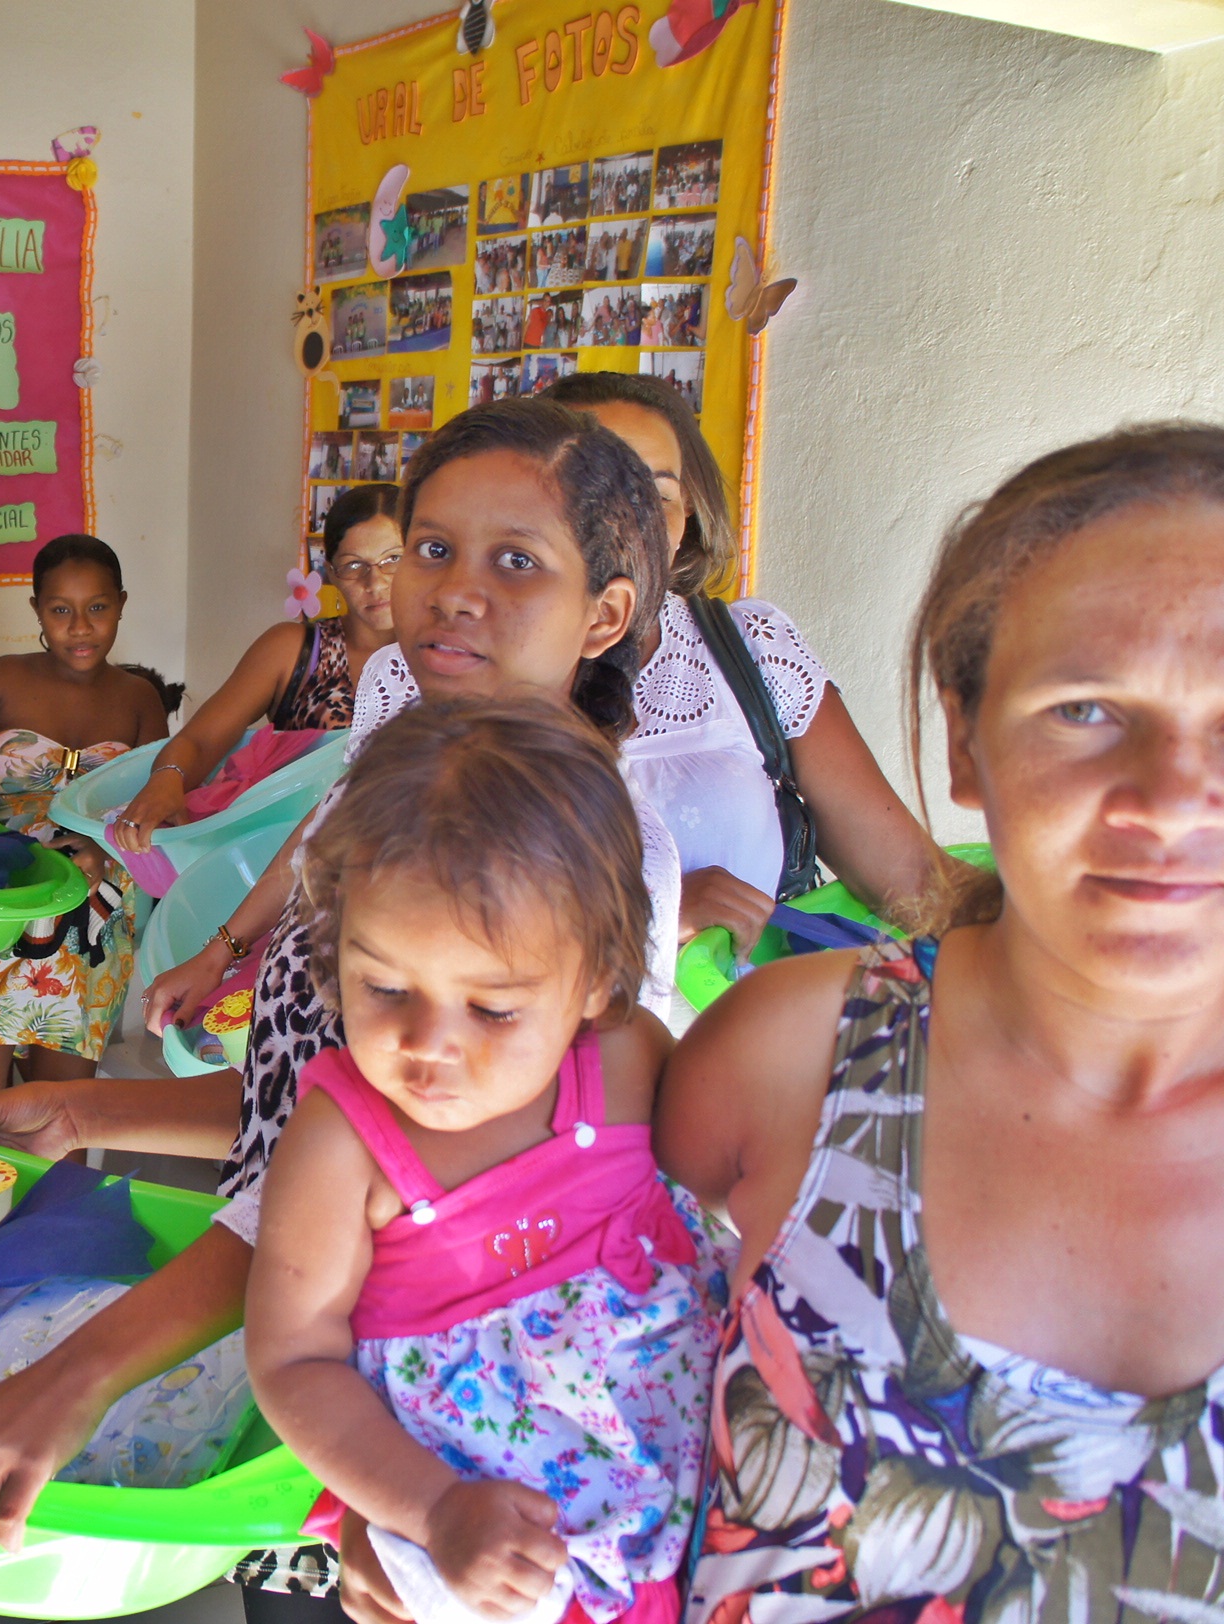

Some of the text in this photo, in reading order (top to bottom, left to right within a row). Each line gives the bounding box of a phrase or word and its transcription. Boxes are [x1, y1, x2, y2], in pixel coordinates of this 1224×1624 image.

[356, 5, 641, 145] URAL DE FOTOS
